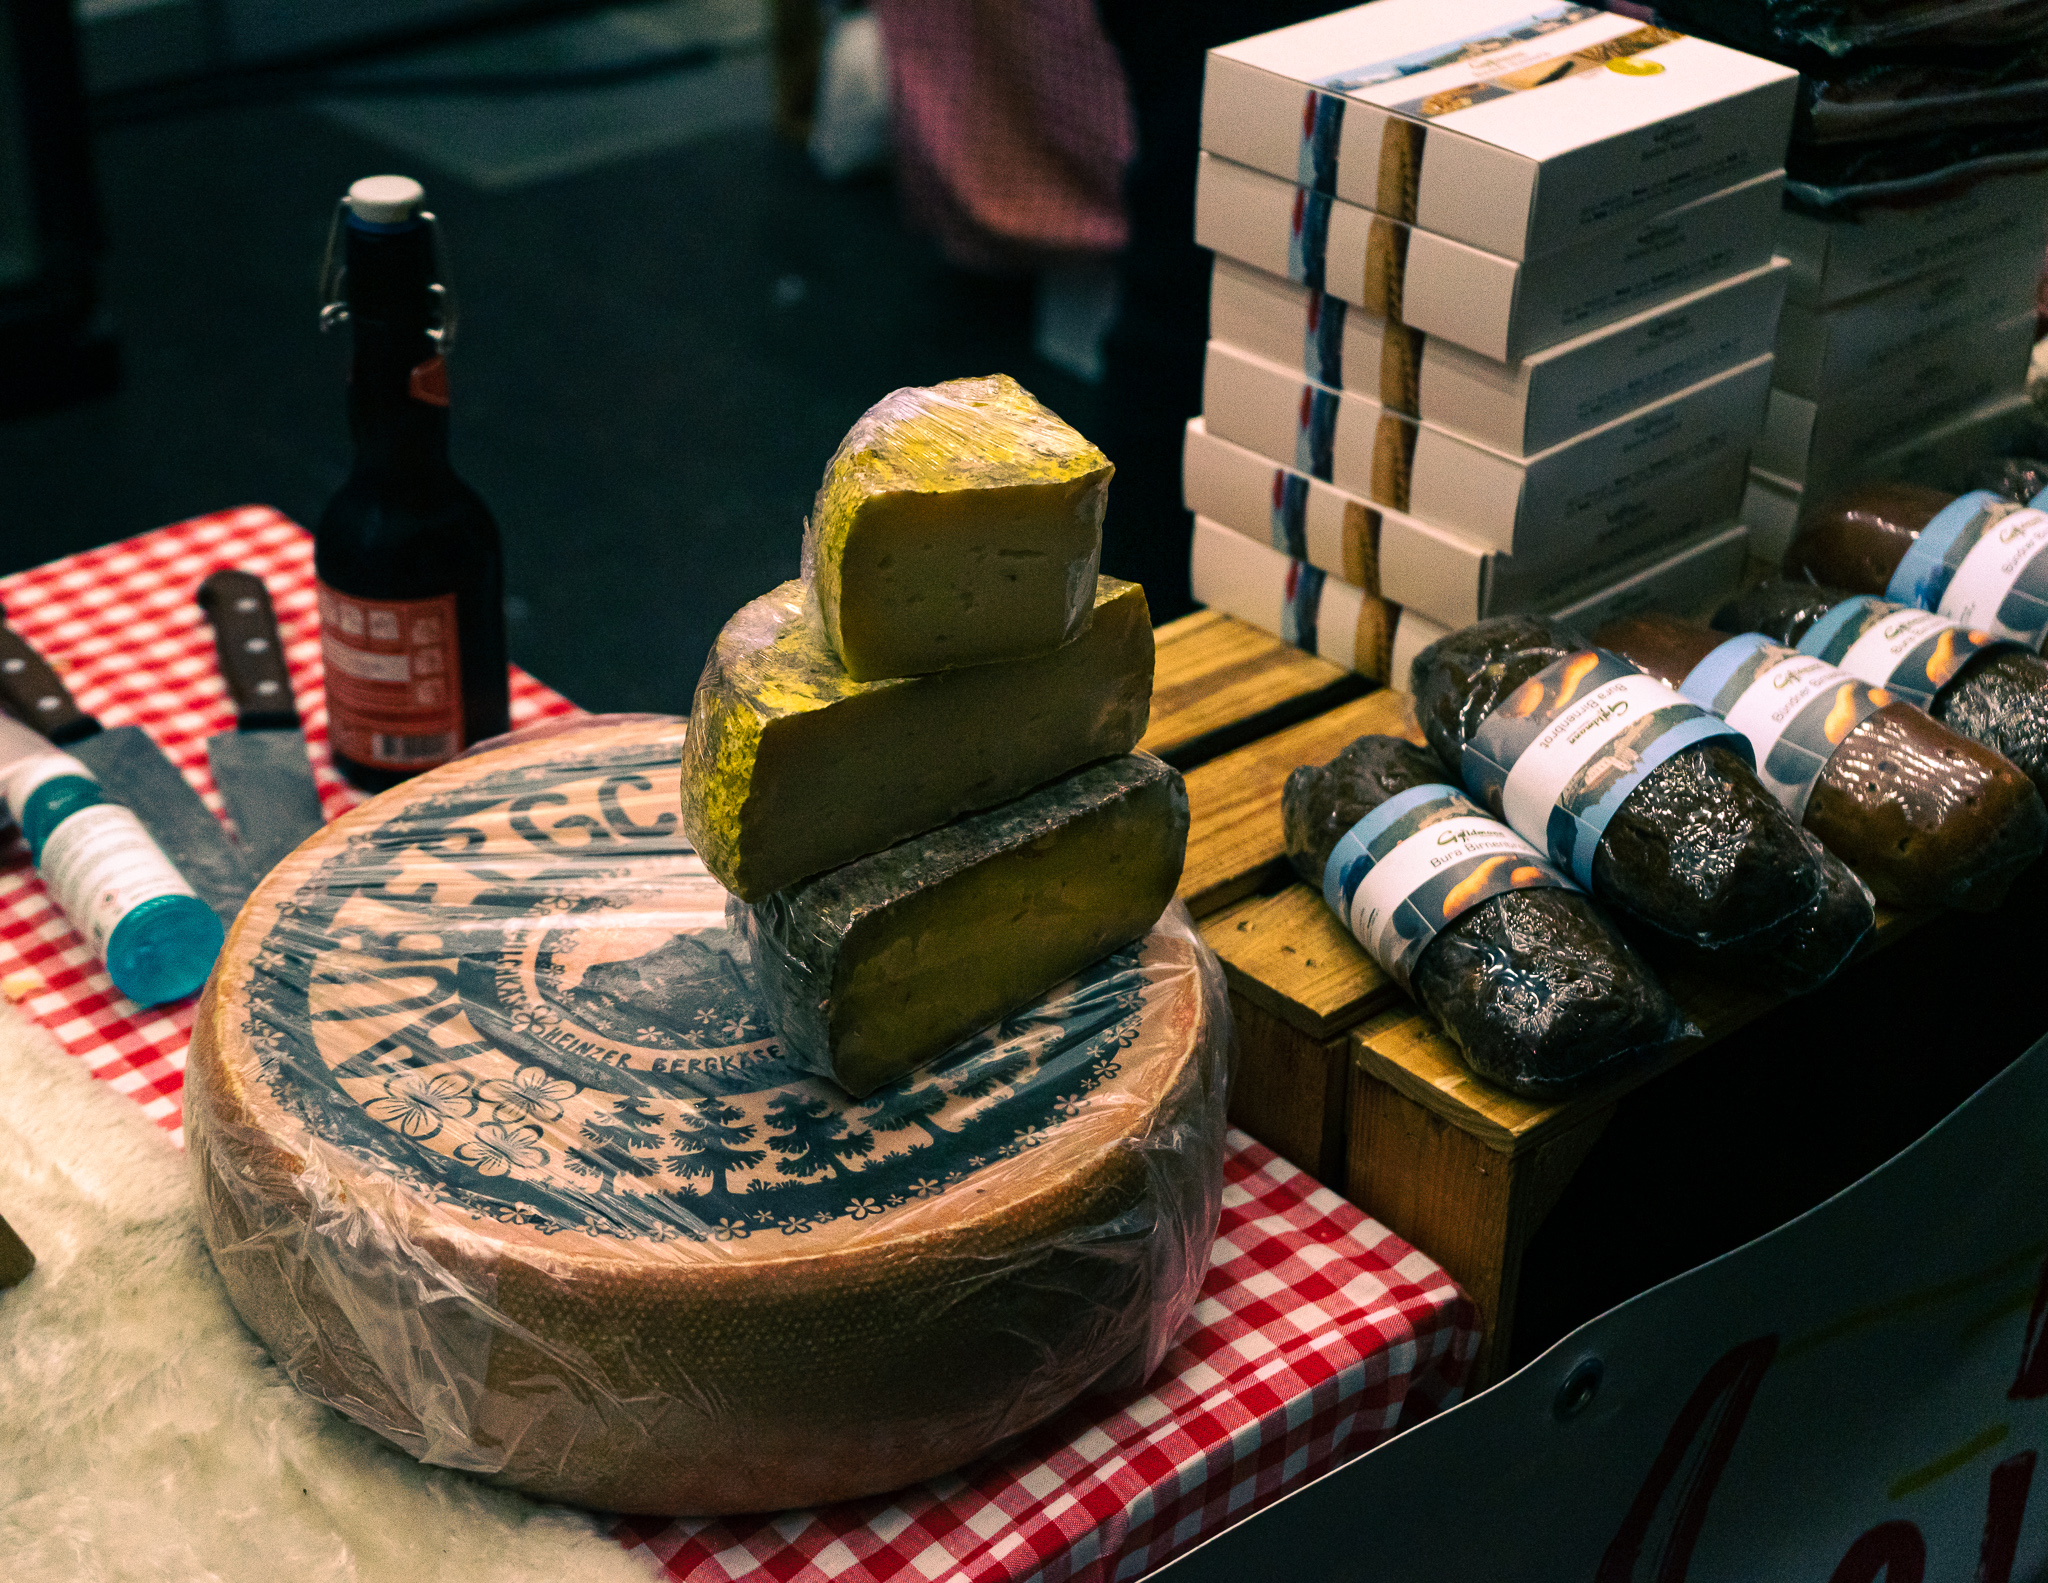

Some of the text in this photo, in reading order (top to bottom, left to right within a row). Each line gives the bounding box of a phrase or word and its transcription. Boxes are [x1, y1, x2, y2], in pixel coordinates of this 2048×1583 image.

[1540, 683, 1628, 749] Bura Birnenbrot
[1430, 847, 1463, 869] Bura
[548, 1028, 633, 1070] HEINZER
